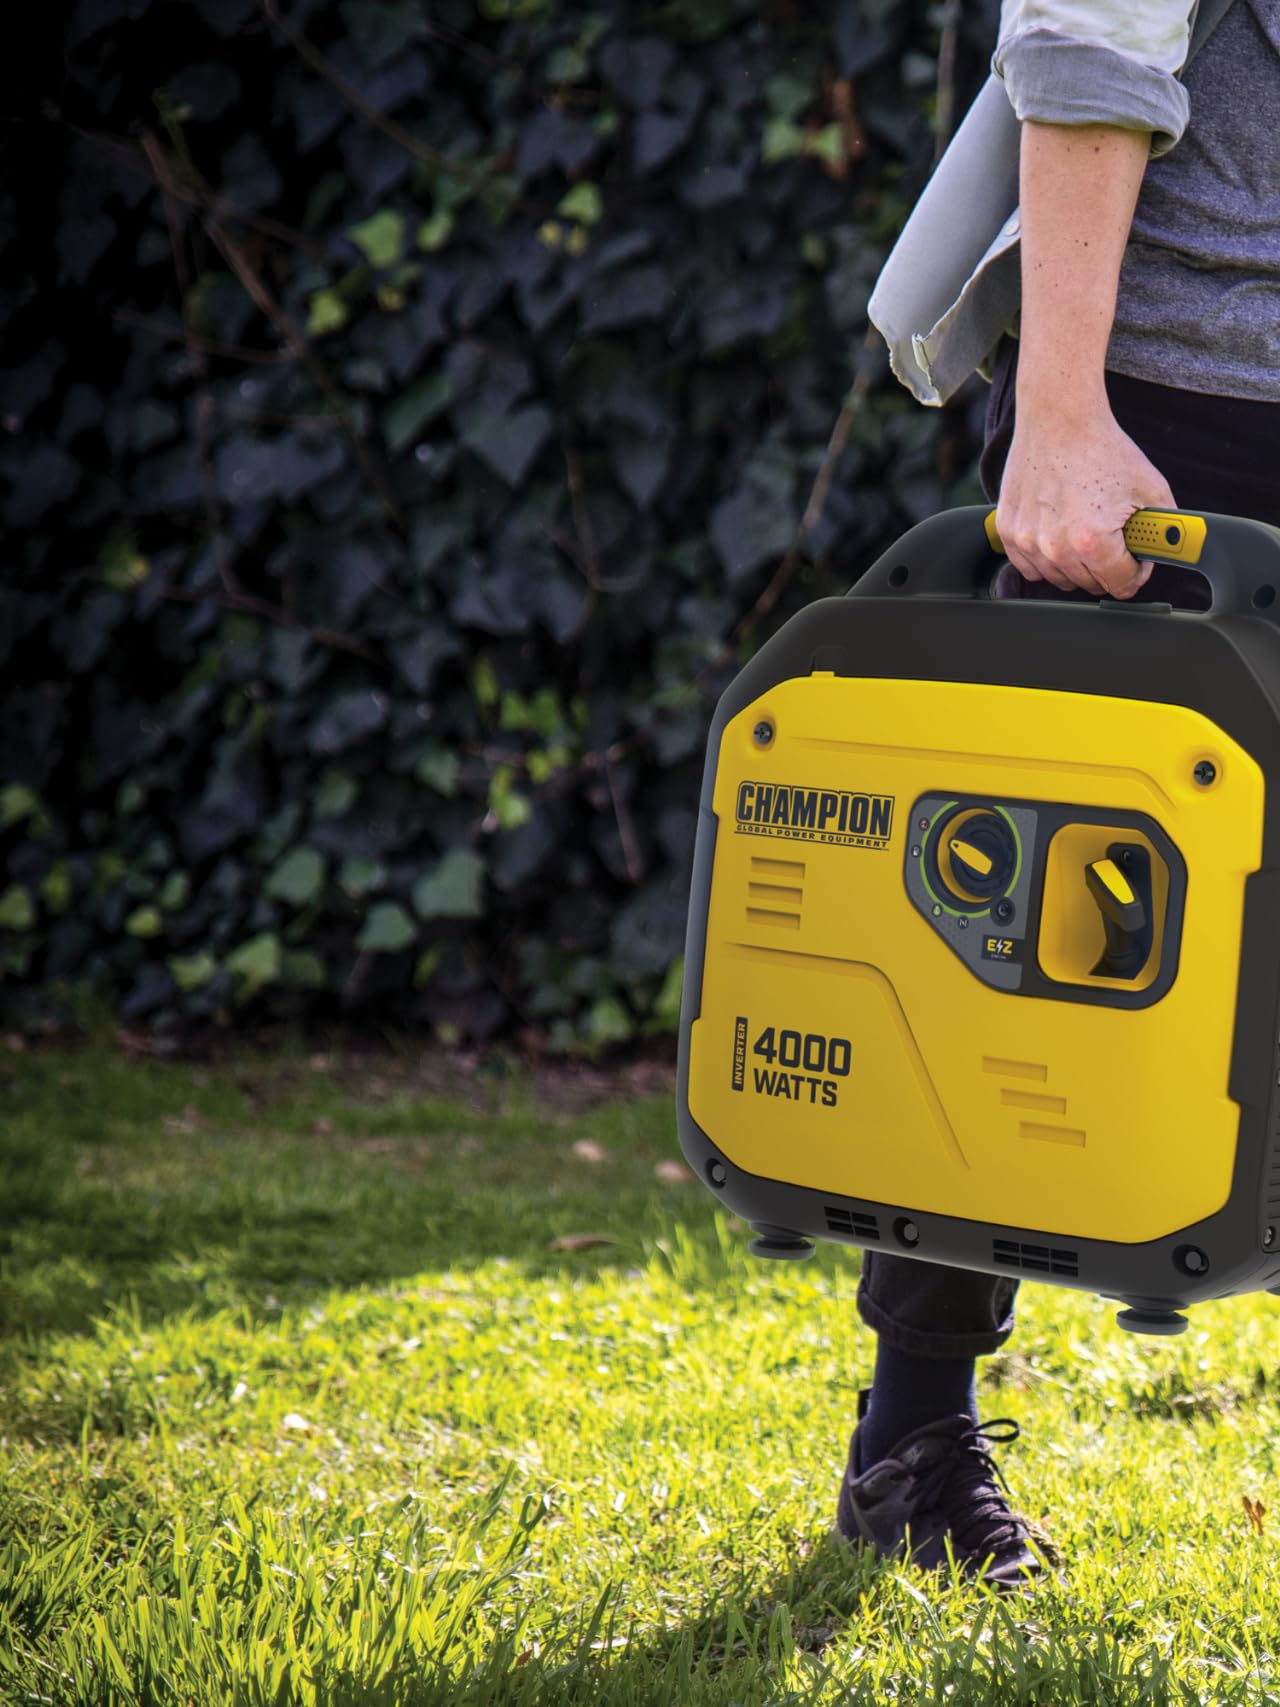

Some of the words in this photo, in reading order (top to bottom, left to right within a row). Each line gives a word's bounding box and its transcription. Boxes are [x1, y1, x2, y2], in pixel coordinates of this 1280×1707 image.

[736, 824, 773, 835] GLOBAL
[776, 829, 815, 840] POWER
[820, 833, 888, 848] EQUIPMENT
[737, 783, 893, 838] CHAMPION
[734, 1022, 746, 1085] INVERTER
[753, 1026, 851, 1077] 4000
[753, 1067, 838, 1107] WATTS
